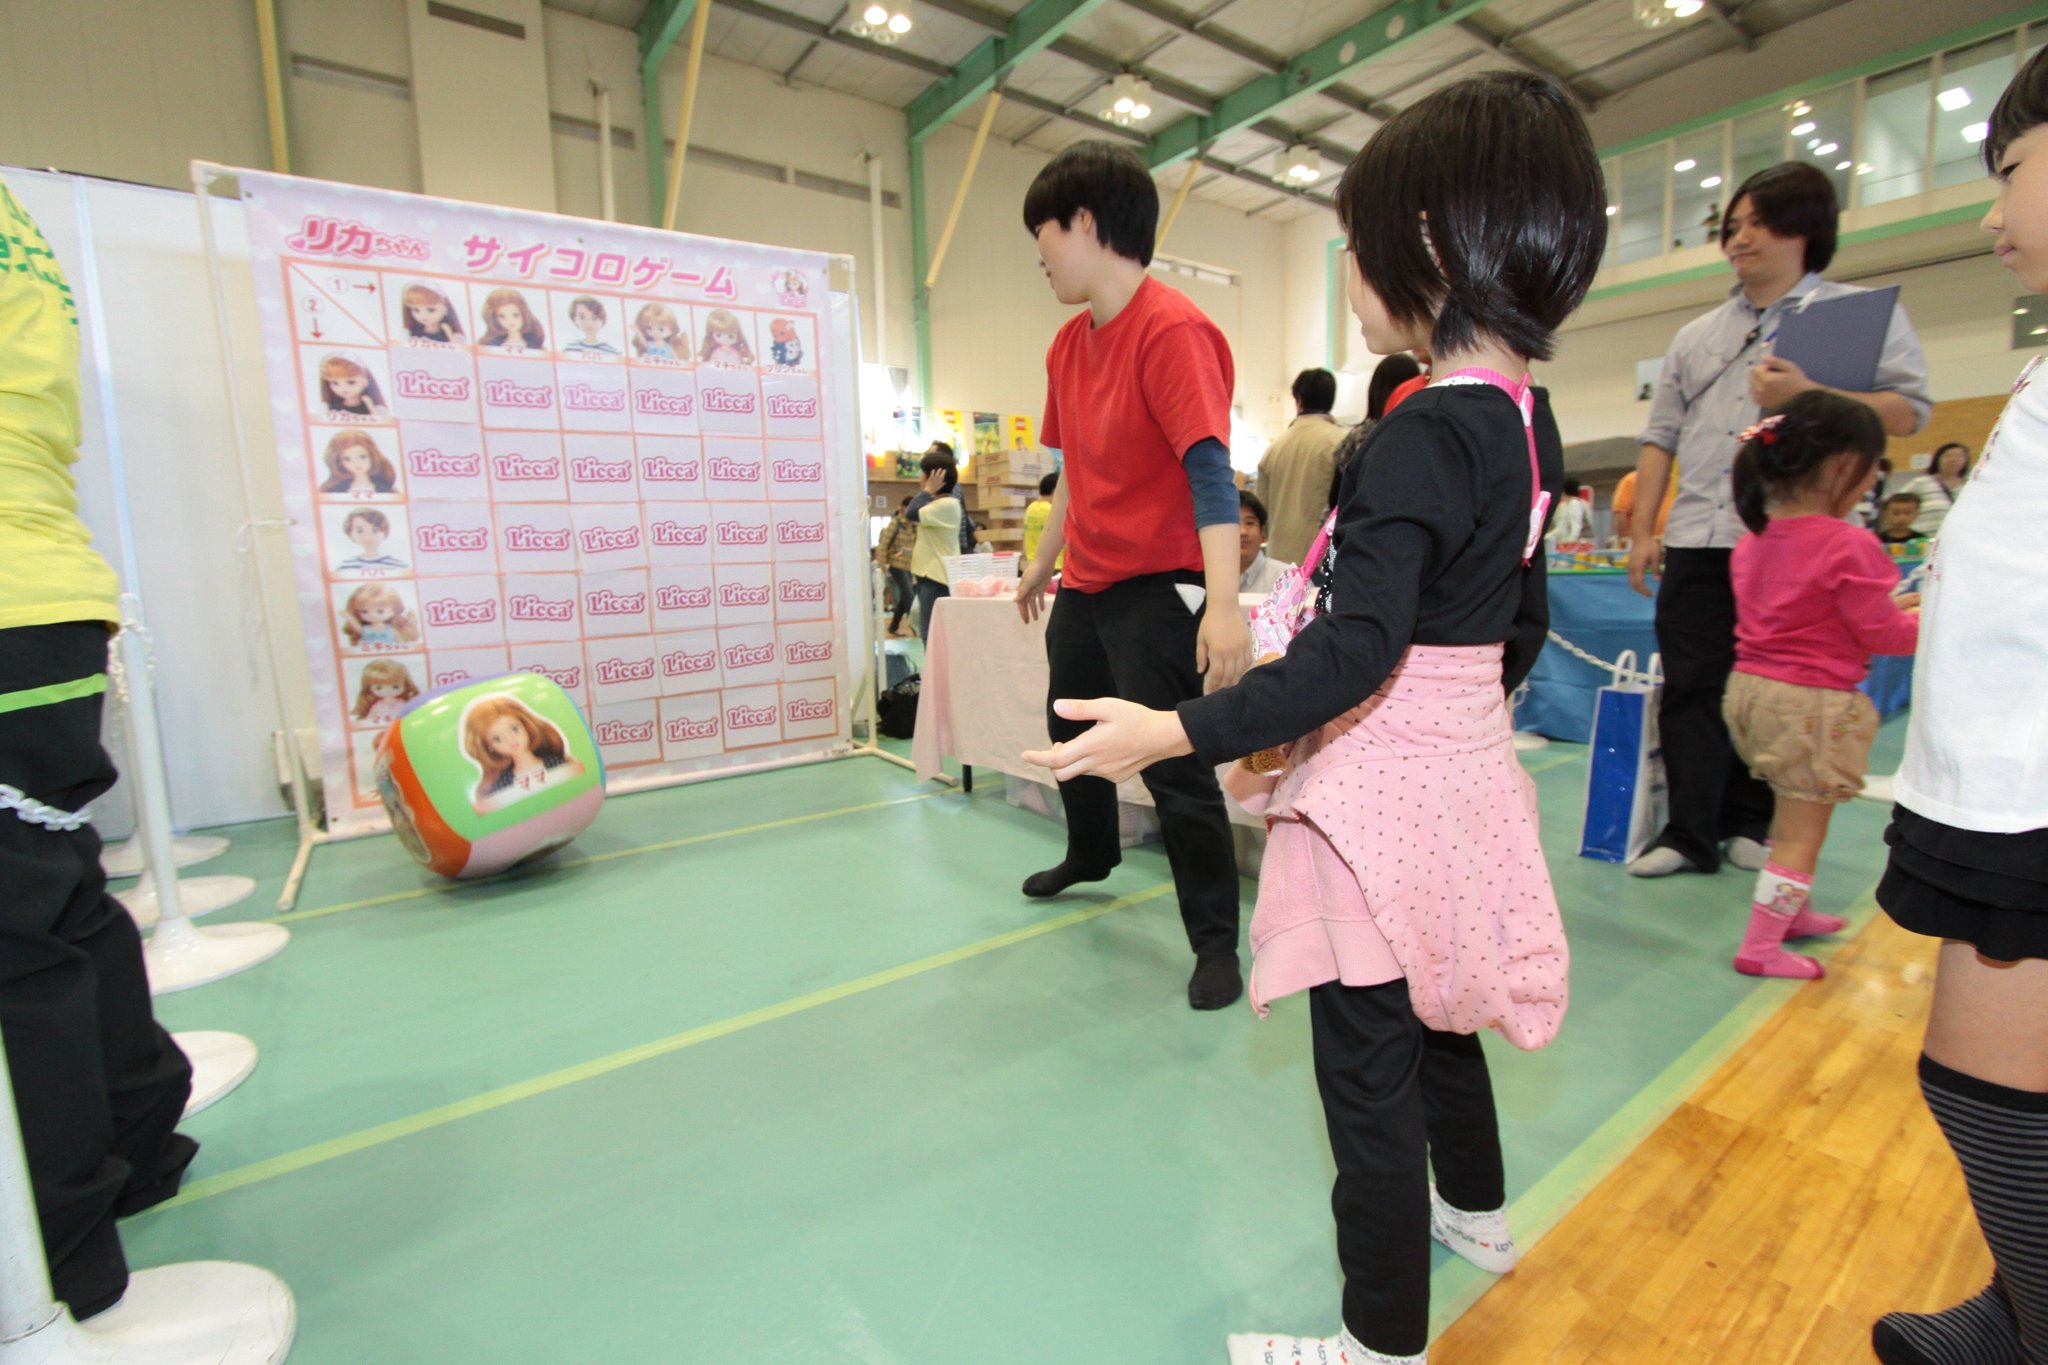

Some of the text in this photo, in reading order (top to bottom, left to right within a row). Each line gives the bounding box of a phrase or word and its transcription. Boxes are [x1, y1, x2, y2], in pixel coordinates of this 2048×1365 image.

[290, 217, 431, 259] リカちゃん
[463, 234, 735, 298] サイコロゲーム
[397, 370, 469, 400] Licca
[486, 380, 551, 408] Licca
[565, 384, 625, 411] Licca
[636, 389, 692, 415] Licca
[703, 388, 754, 413] Licca
[768, 395, 817, 418] Licca
[409, 448, 480, 477] Licca
[493, 453, 559, 480] Licca
[572, 457, 632, 483] Licca
[643, 458, 699, 482] Licca
[708, 457, 761, 482] Licca
[774, 460, 821, 483] Licca
[416, 524, 488, 552] Licca
[506, 525, 570, 552] Licca
[582, 526, 639, 553] Licca
[652, 521, 707, 545] Licca
[718, 521, 767, 545] Licca
[777, 521, 824, 544] Licca
[587, 589, 645, 616] Licca
[657, 584, 711, 610] Licca
[720, 581, 769, 606] Licca
[780, 579, 825, 603] Licca
[427, 598, 497, 626] Licca
[510, 594, 574, 622] Licca
[662, 650, 716, 677] Licca
[725, 642, 774, 669] Licca
[786, 639, 833, 663] Licca
[596, 657, 654, 684] Licca
[728, 704, 777, 729] Licca
[787, 699, 833, 721] Licca
[596, 718, 653, 745] Licca
[665, 716, 719, 744] Licca
[516, 770, 546, 790] ママ
